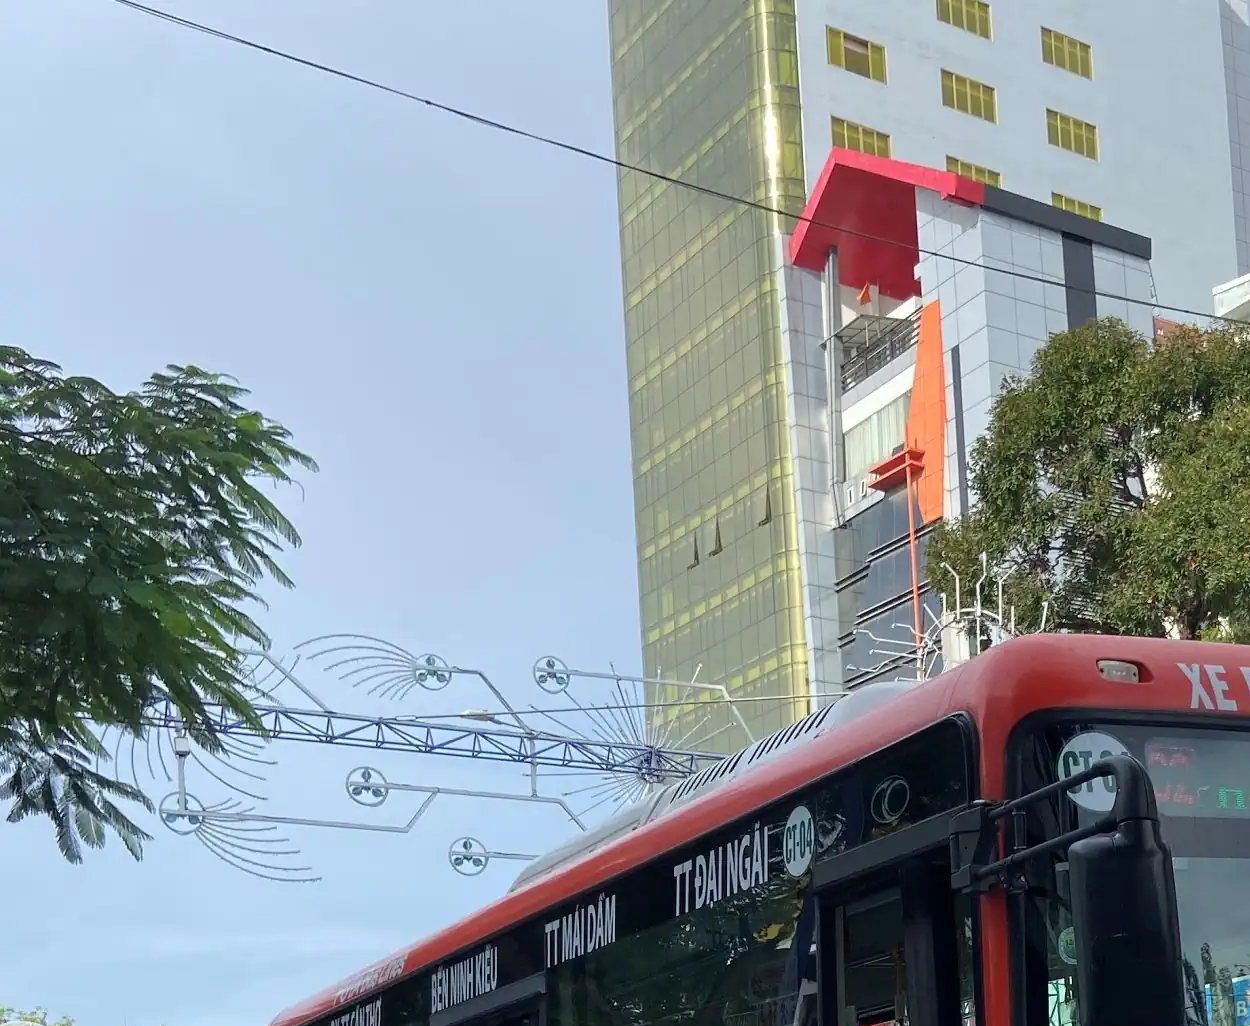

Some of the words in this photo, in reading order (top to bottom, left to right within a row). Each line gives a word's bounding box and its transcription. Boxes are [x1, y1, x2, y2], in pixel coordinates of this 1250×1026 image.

[1176, 662, 1238, 712] XE
[673, 859, 693, 917] TT
[695, 846, 723, 910] ĐẠI
[726, 820, 769, 897] NGÃI
[785, 816, 814, 865] CT-04
[545, 919, 561, 968] TT
[562, 904, 585, 963] MÁI
[587, 892, 616, 953] DẦM
[431, 965, 449, 1014] BẾN
[450, 956, 474, 1007] NINH
[475, 943, 498, 997] KIỀU
